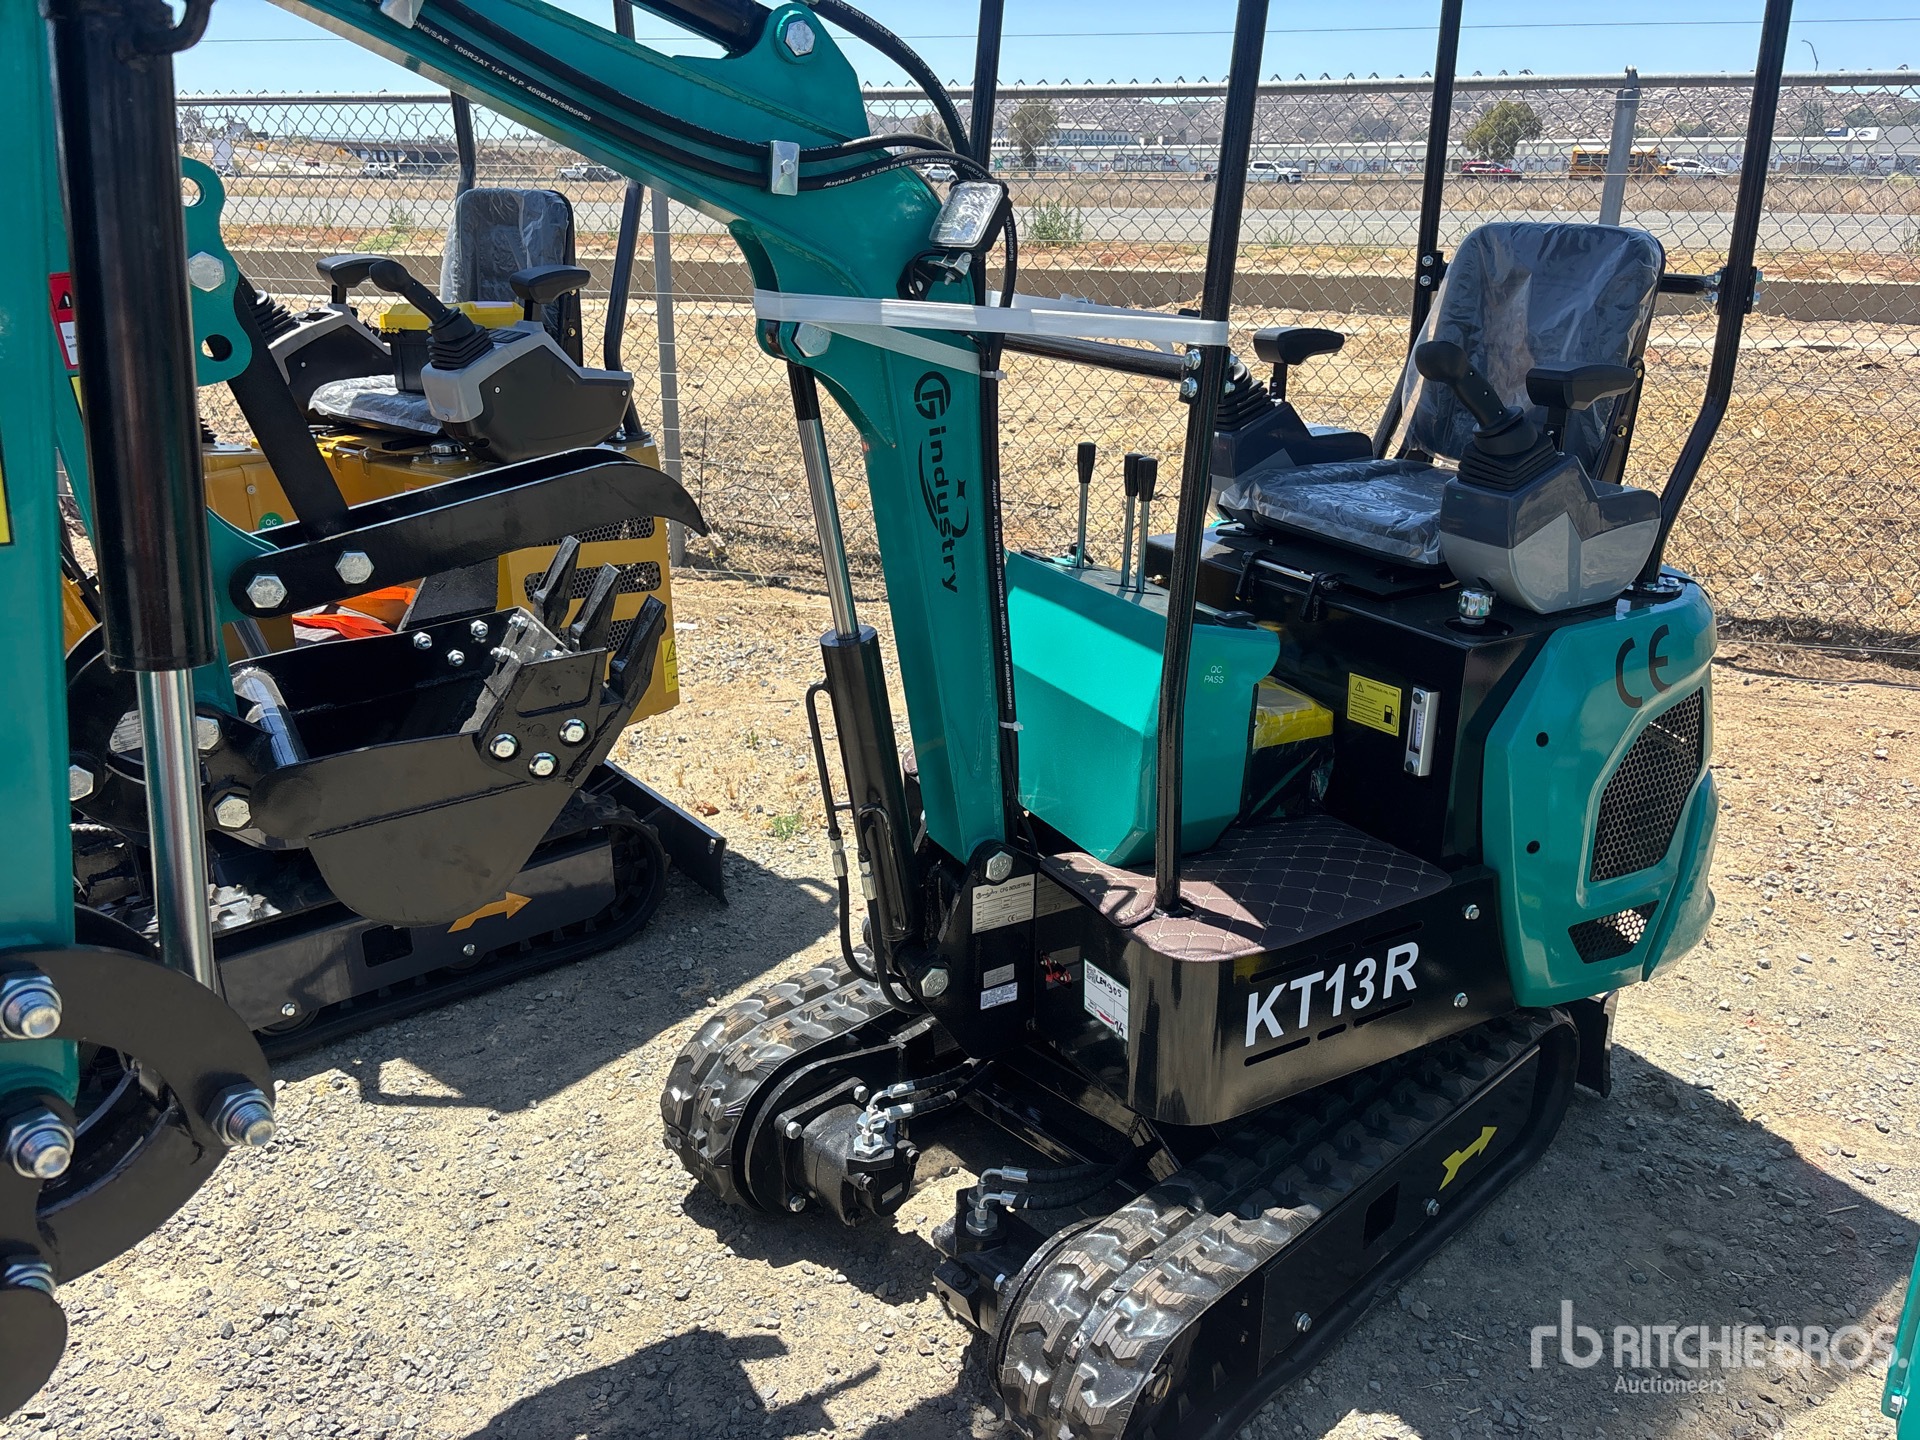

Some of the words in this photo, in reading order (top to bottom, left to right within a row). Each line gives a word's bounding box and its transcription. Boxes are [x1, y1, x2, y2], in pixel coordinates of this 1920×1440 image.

[454, 44, 490, 68] 100R2AT
[526, 85, 592, 122] 400BAR/5800PSI
[1204, 675, 1224, 684] PASS
[1210, 665, 1222, 674] QC
[1616, 624, 1672, 708] CE
[1245, 942, 1419, 1048] KT13R
